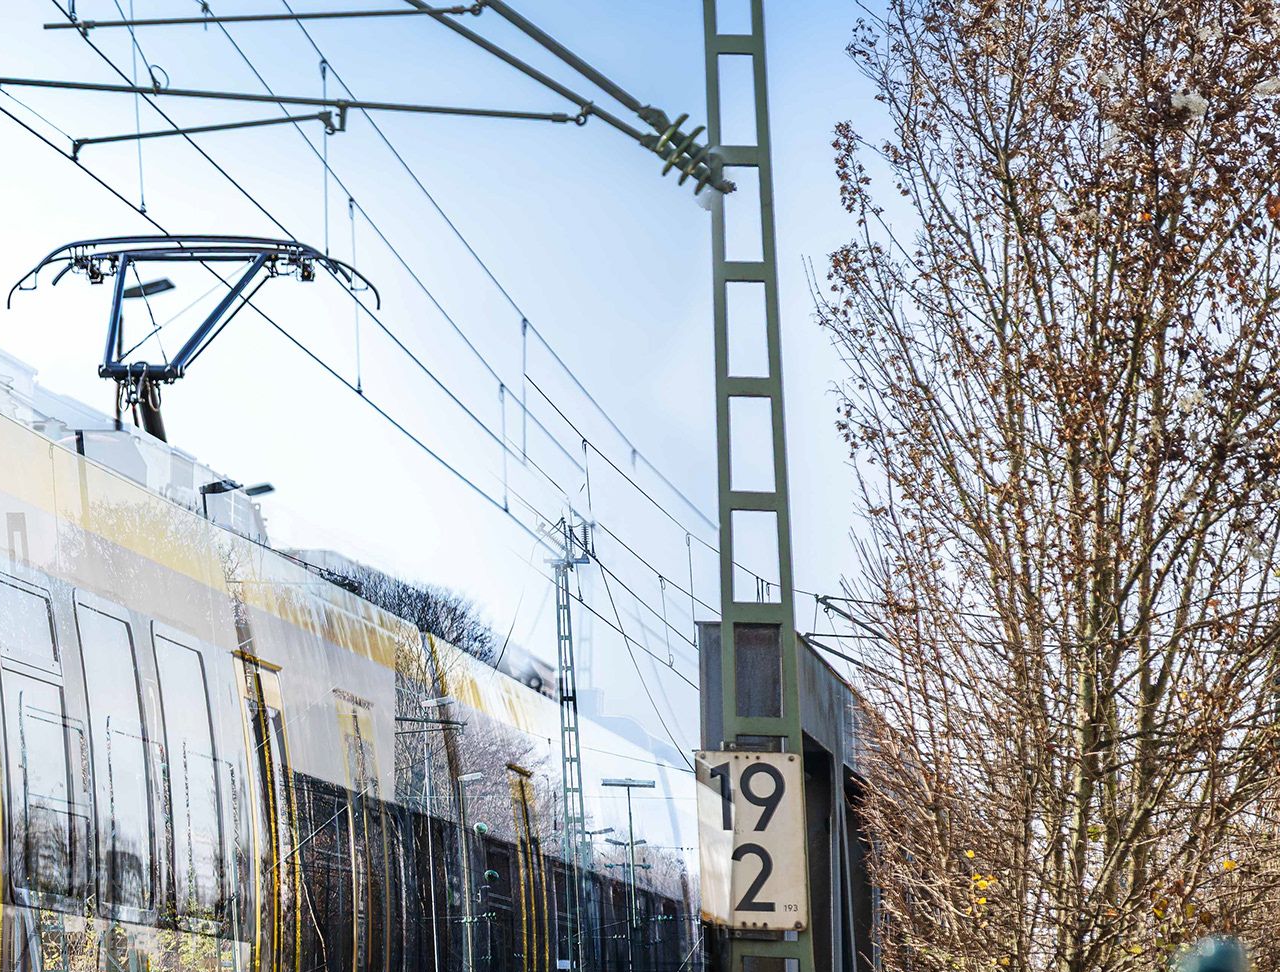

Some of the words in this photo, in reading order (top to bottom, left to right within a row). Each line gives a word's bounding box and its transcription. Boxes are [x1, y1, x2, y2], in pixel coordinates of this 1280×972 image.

[710, 762, 786, 832] 19
[731, 842, 776, 912] 2
[783, 904, 799, 912] 193
